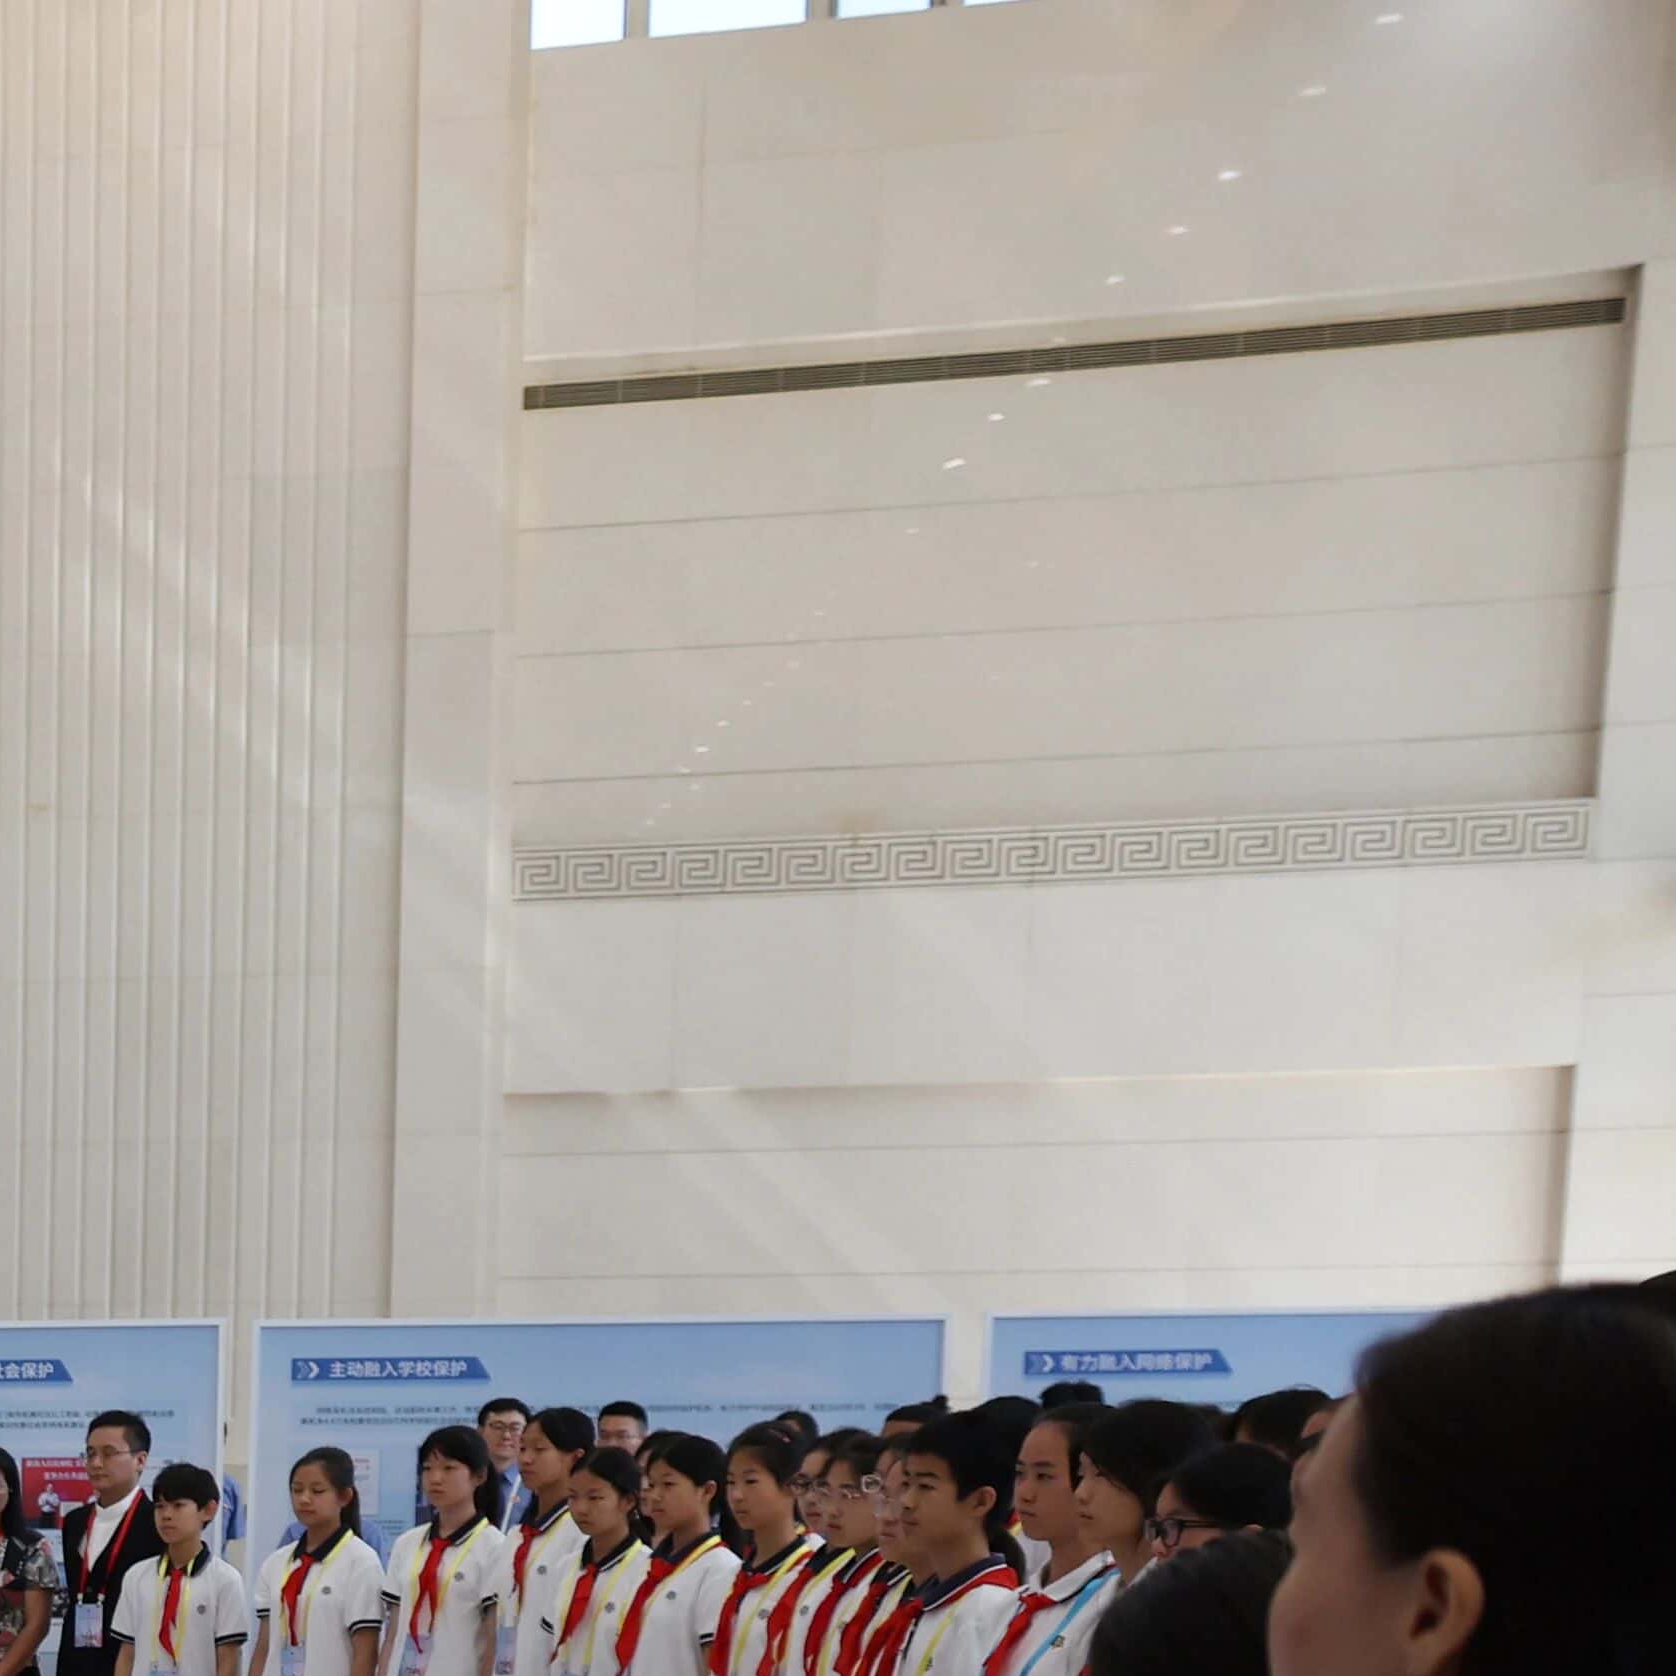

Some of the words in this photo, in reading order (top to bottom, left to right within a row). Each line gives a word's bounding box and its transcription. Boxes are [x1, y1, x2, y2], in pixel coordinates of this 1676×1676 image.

[329, 1360, 468, 1378] 主动融入学校保护
[1060, 1353, 1213, 1371] 有力融入网络保护
